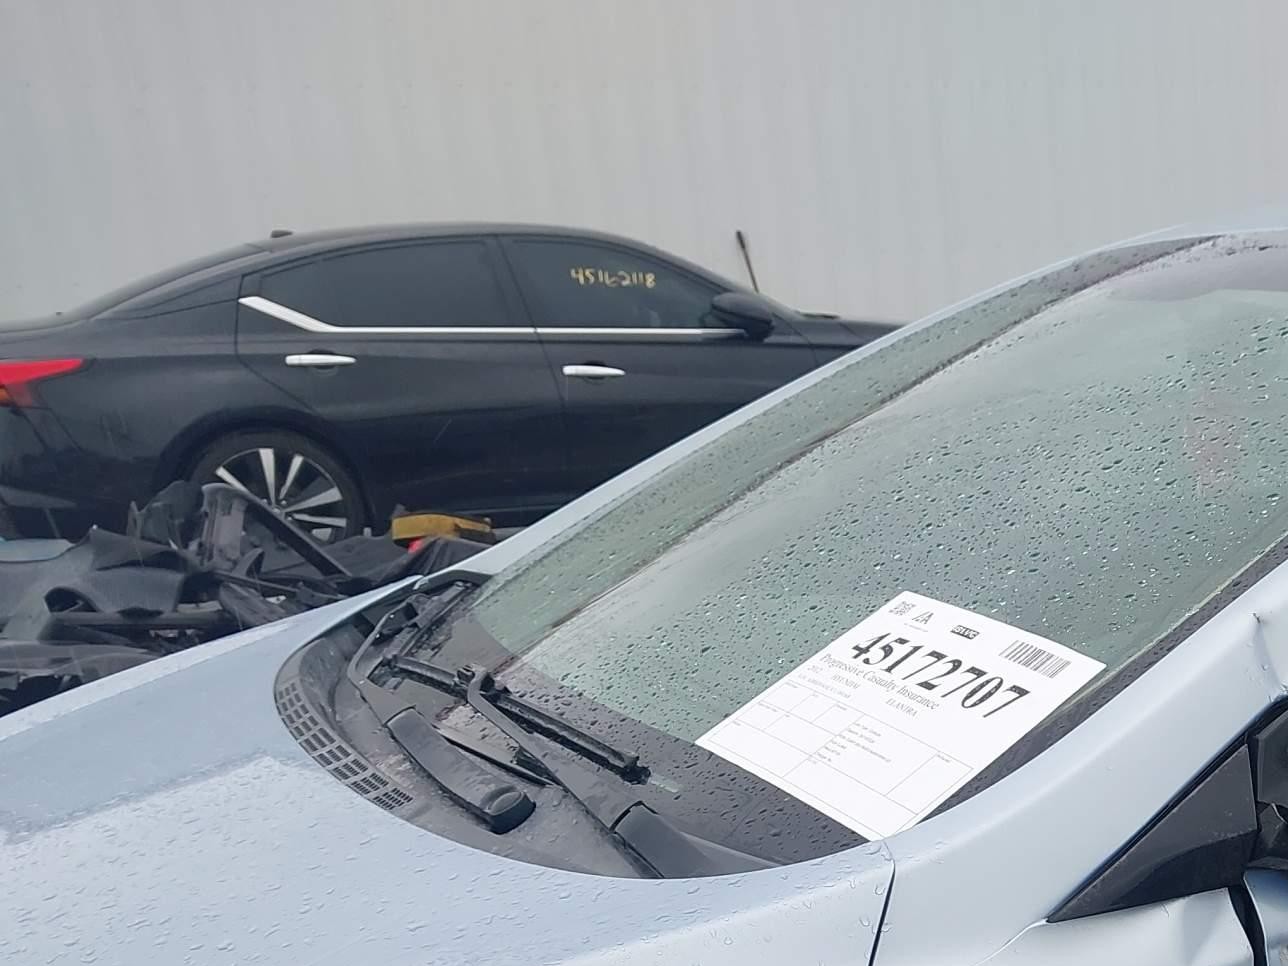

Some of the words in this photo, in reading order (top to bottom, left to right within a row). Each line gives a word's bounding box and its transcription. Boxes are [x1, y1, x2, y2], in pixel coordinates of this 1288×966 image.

[570, 266, 656, 288] 45162118
[819, 653, 865, 677] Progressive
[862, 670, 898, 693] Casualty
[896, 685, 941, 710] Insurance
[851, 632, 1032, 719] 45172707
